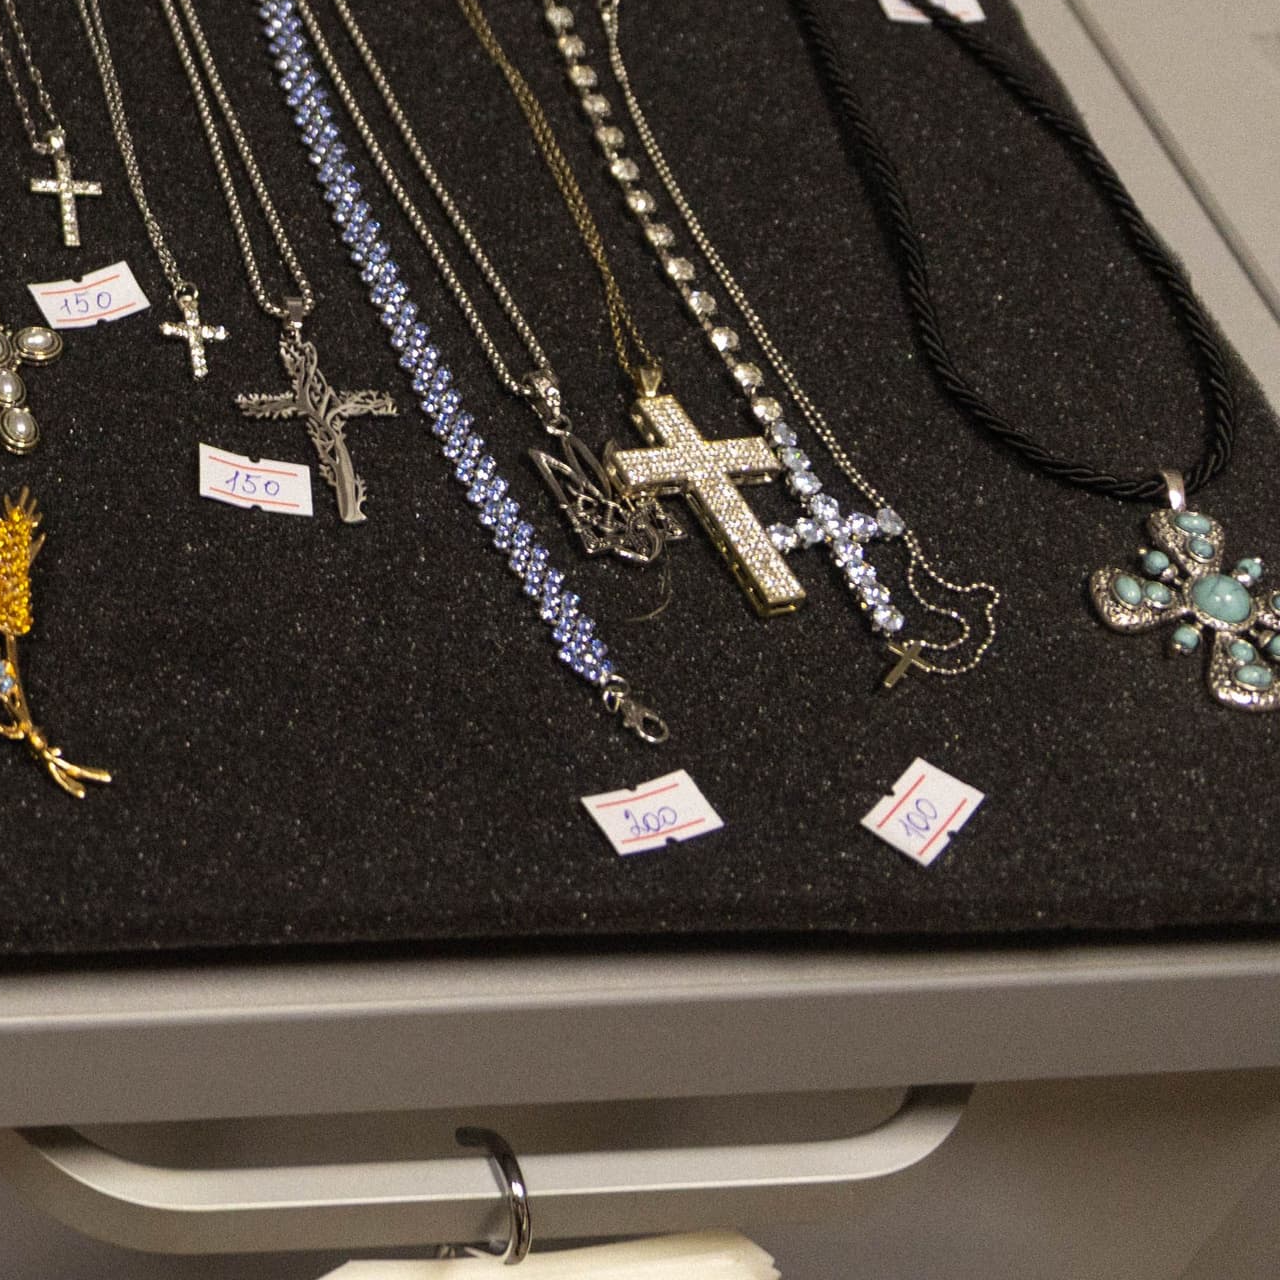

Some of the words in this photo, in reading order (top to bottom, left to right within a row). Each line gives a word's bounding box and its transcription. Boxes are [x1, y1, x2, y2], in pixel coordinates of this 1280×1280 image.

[59, 290, 113, 315] 150
[225, 470, 281, 497] 150
[623, 806, 678, 836] 200
[898, 797, 938, 840] 100
